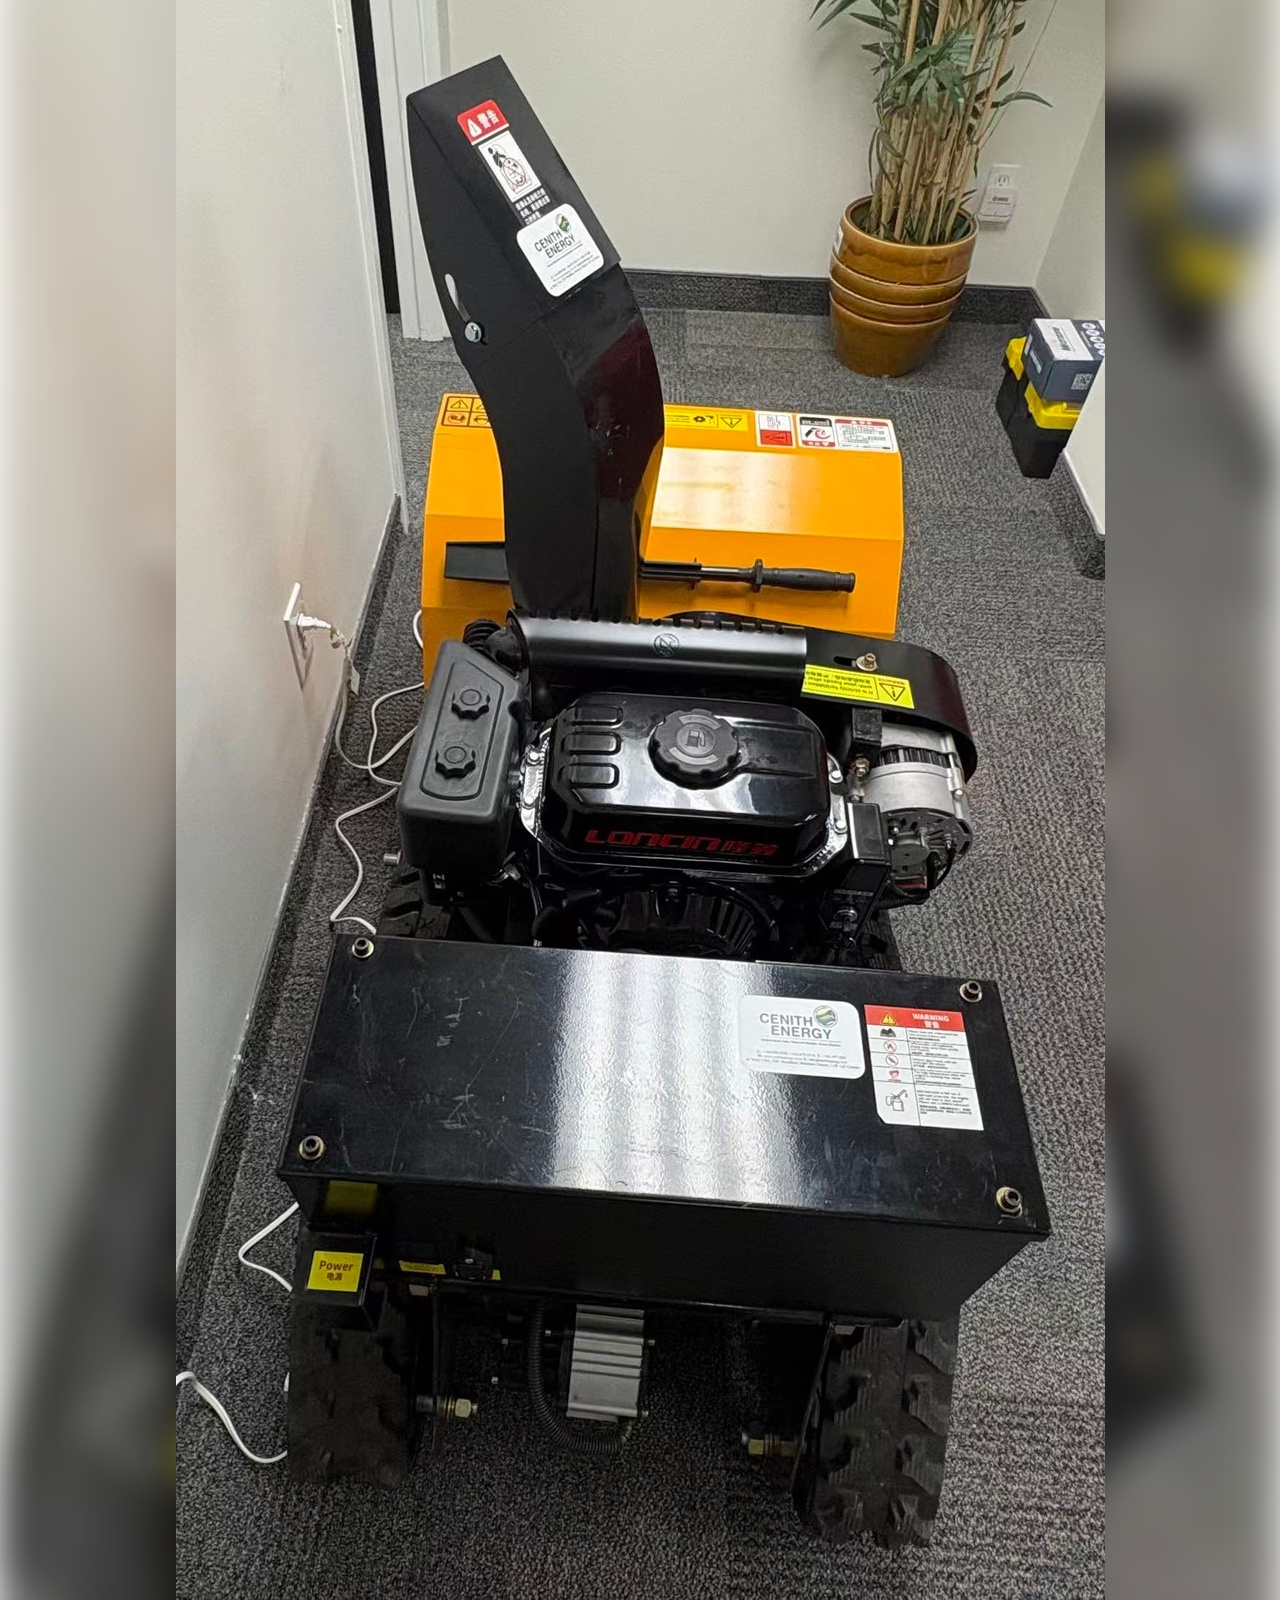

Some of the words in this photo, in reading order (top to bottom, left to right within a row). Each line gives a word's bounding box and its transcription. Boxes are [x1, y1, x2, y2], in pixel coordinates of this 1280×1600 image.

[534, 231, 563, 252] CENITH
[545, 234, 577, 258] ENERGY
[759, 1012, 813, 1027] CENITH
[912, 1012, 950, 1023] WARNING
[770, 1025, 832, 1040] ENERGY
[319, 1260, 354, 1271] Power
